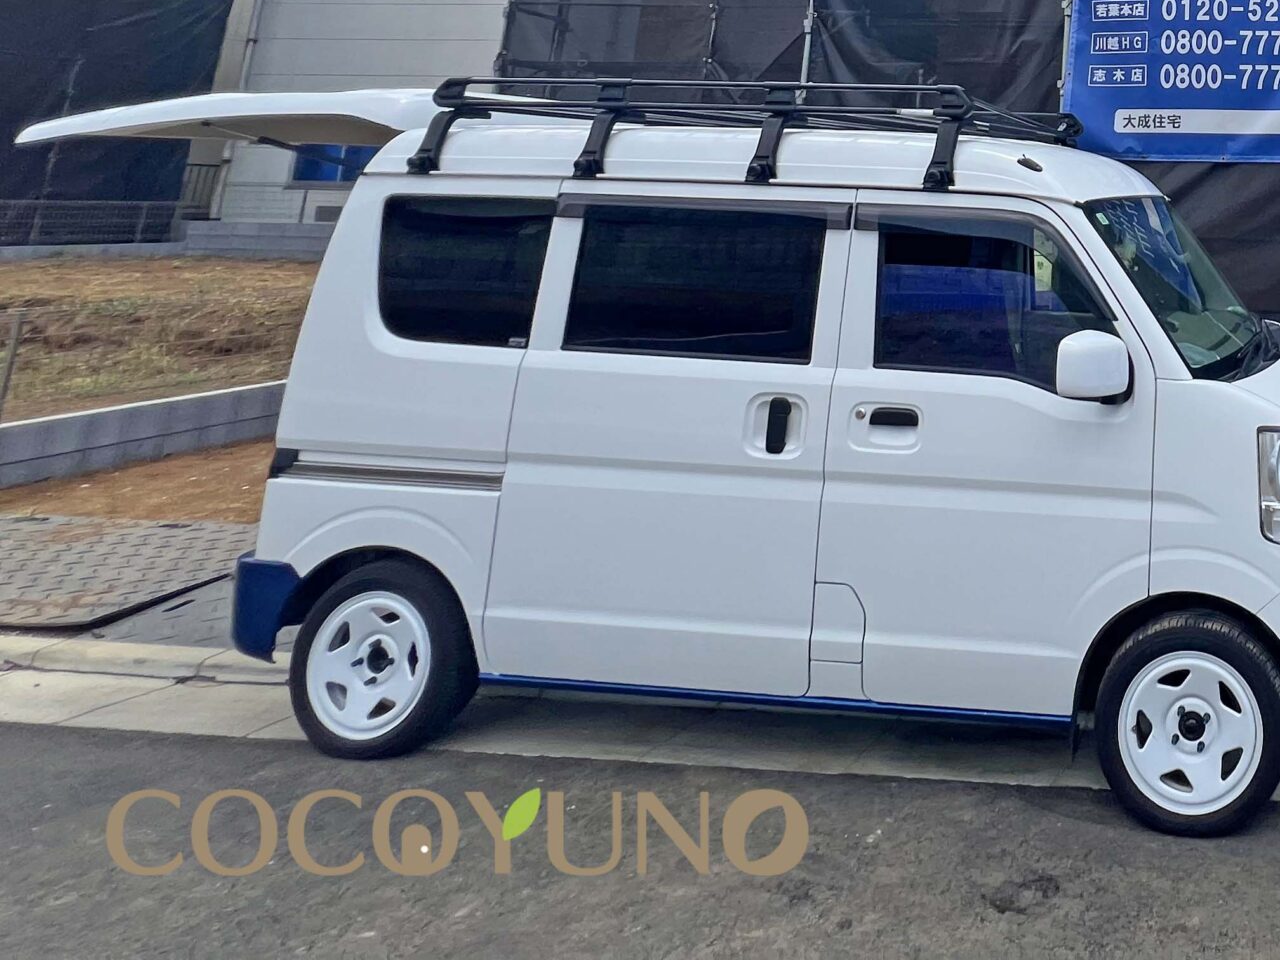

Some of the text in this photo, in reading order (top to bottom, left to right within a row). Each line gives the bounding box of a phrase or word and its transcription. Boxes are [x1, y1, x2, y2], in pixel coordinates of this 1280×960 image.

[1095, 3, 1145, 18] 若葉本店
[1092, 69, 1143, 83] 志木店
[1122, 114, 1182, 129] 大成住宅
